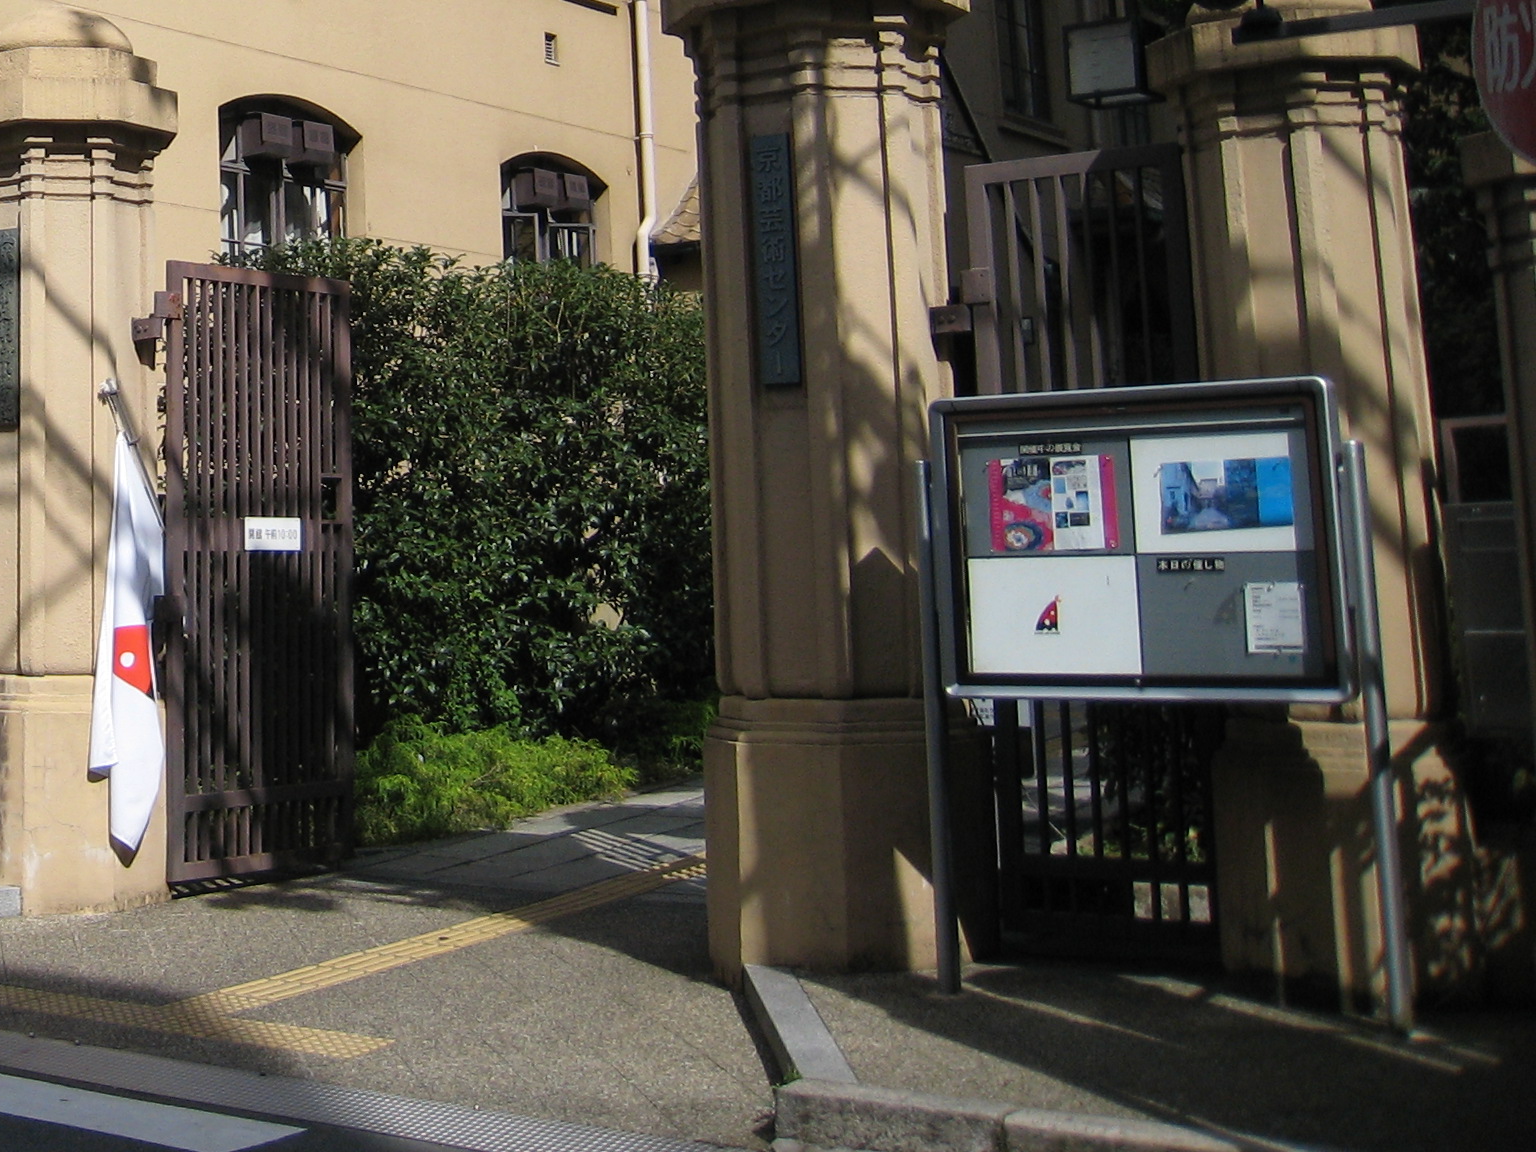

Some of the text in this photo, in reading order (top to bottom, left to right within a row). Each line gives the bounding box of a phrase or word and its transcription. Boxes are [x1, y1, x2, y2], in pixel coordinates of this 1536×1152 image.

[756, 147, 788, 375] 京都芸術センター
[1159, 559, 1225, 571] 本日の催し物
